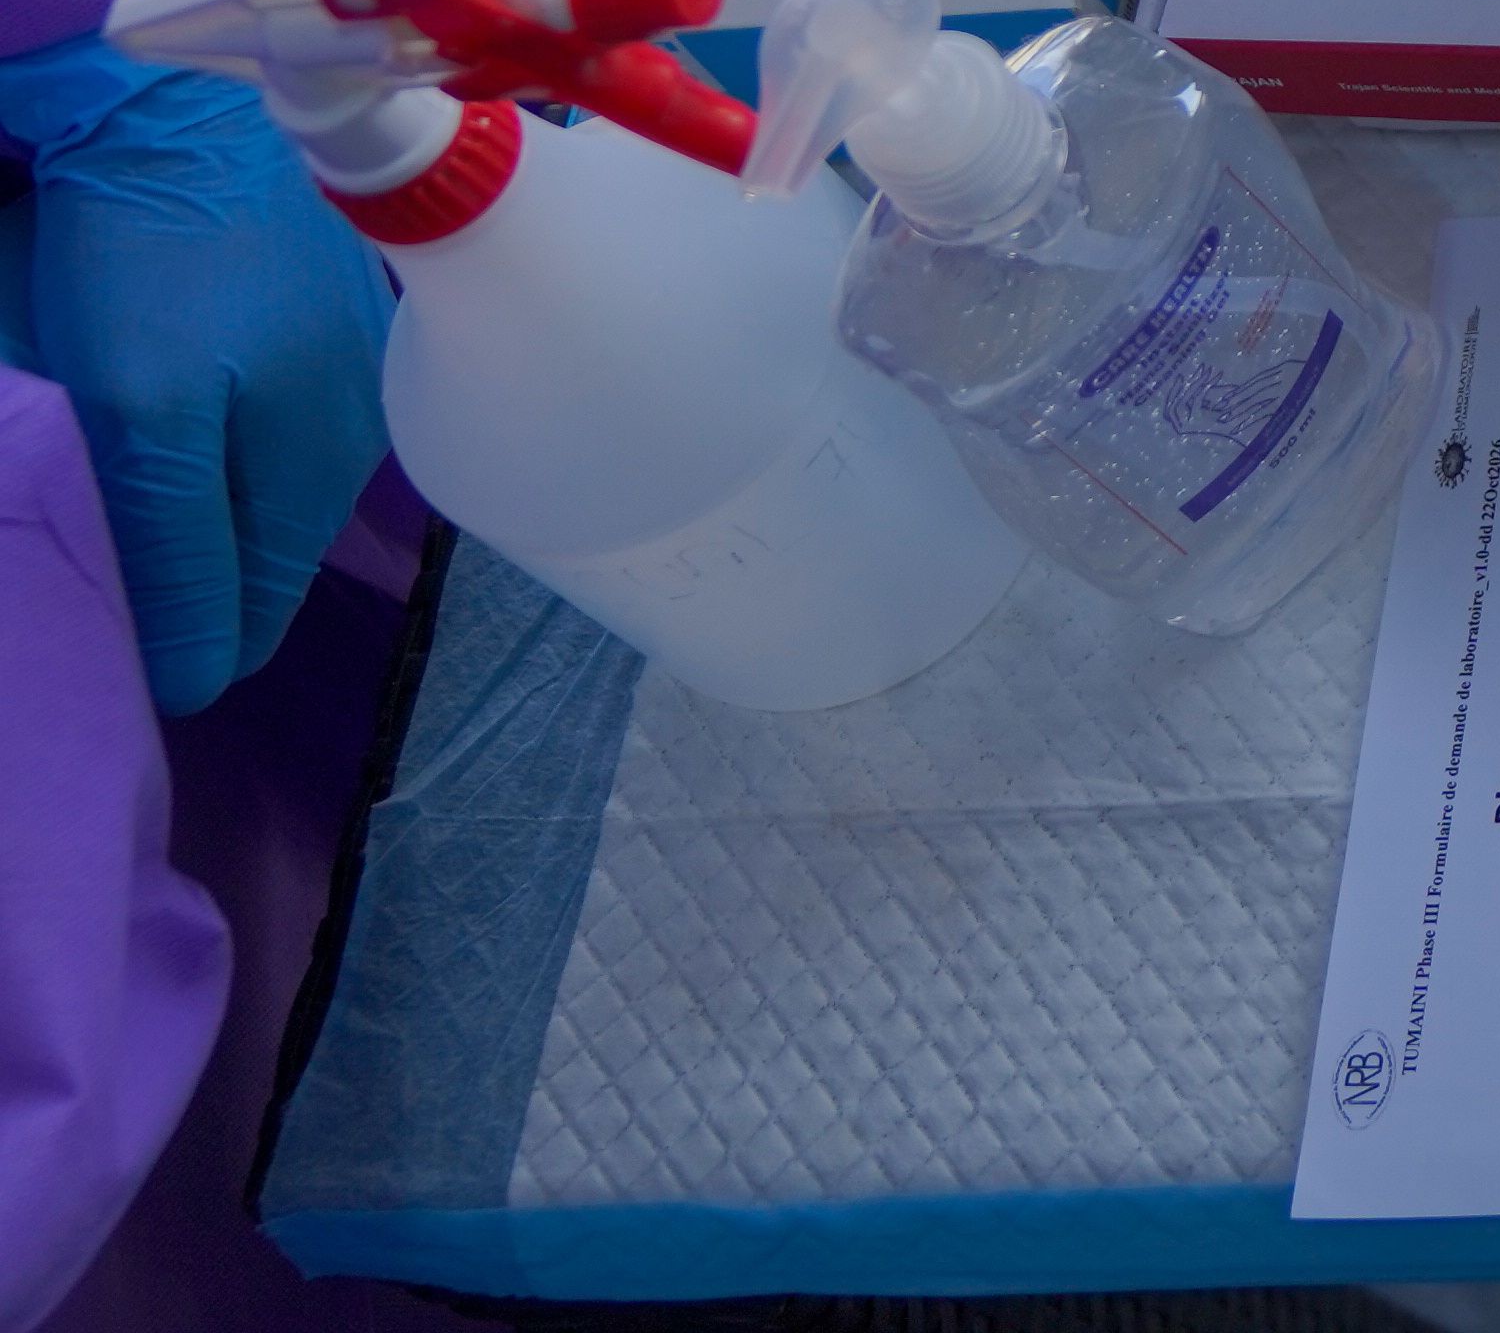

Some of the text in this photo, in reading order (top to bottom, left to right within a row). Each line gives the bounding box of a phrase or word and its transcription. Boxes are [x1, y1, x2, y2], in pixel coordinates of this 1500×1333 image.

[1337, 81, 1380, 93] Trajan
[1380, 83, 1444, 94] Scientific
[1445, 86, 1472, 95] and
[1457, 523, 1495, 677] laboratoire_v1.0-dd
[1455, 680, 1472, 700] de
[1443, 701, 1470, 778] demande
[1440, 780, 1458, 800] de
[1425, 802, 1455, 897] Formulaire
[1422, 902, 1440, 924] III
[1414, 928, 1436, 979] Phase
[1399, 983, 1430, 1077] TUMAINI
